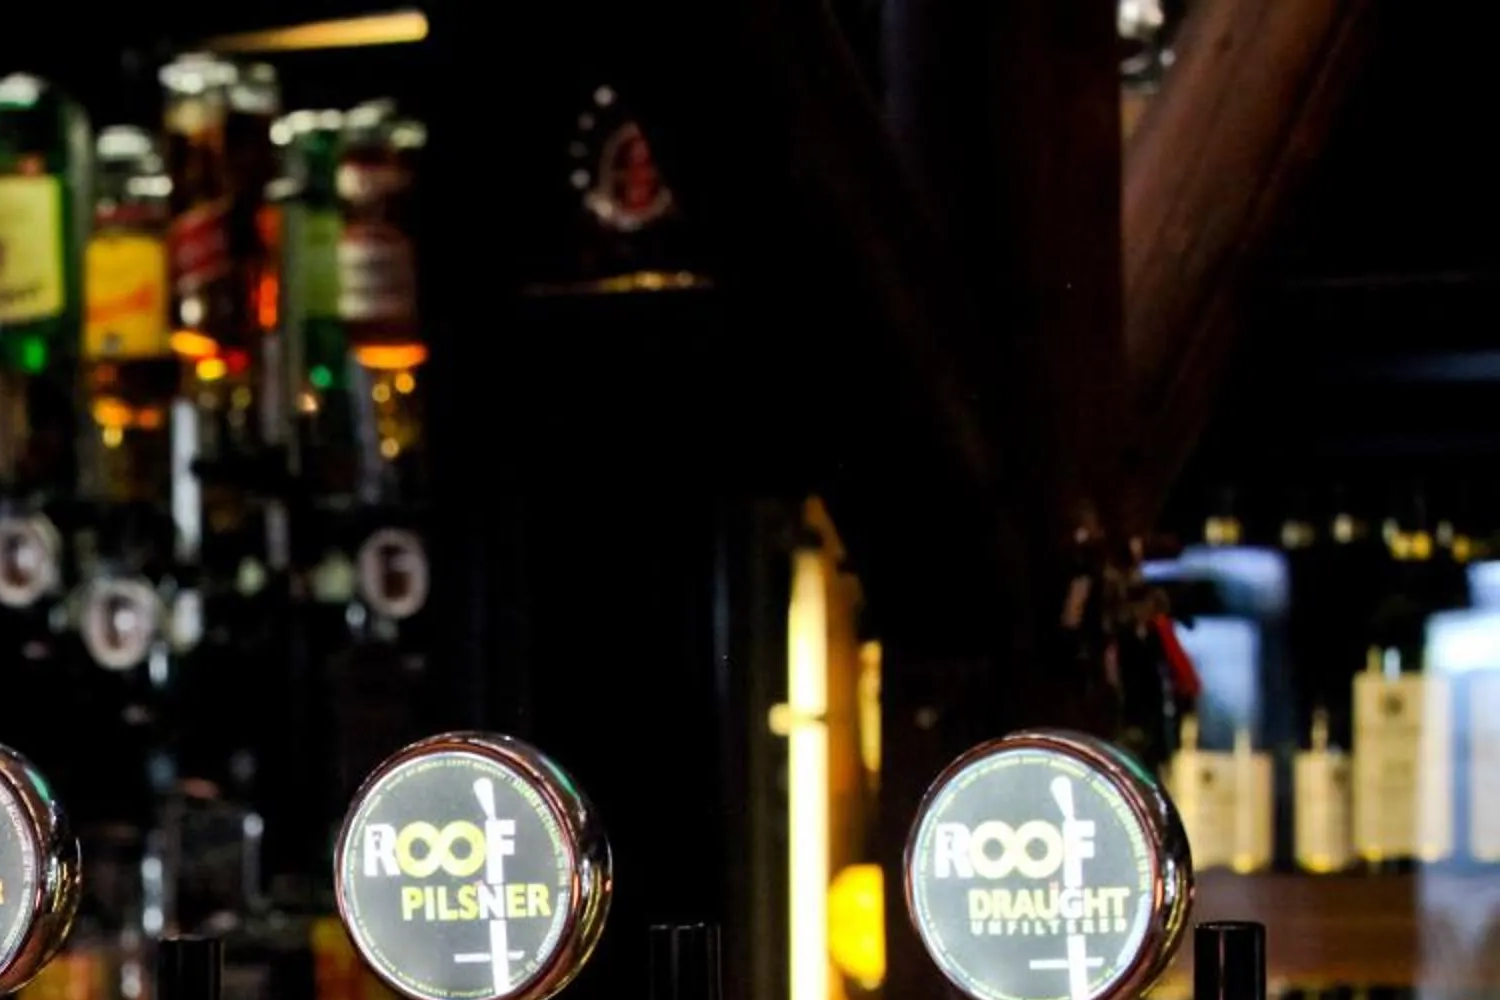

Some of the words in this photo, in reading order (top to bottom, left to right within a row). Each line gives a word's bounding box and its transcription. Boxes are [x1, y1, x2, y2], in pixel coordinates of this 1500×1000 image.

[362, 818, 517, 881] ROOF
[933, 819, 1097, 883] ROOF
[400, 882, 552, 922] PILSNER
[967, 885, 1132, 920] DRAUGHT
